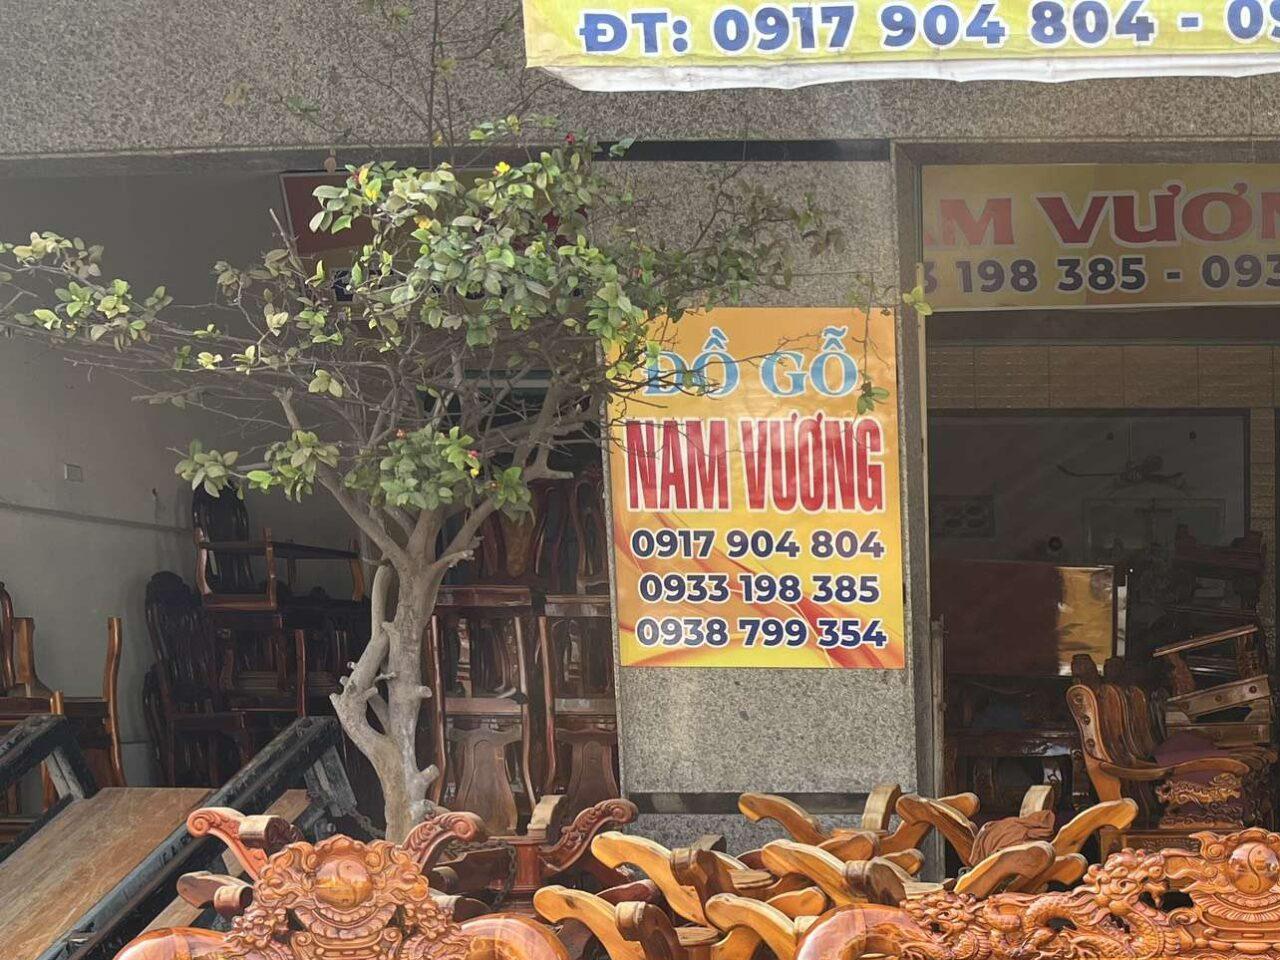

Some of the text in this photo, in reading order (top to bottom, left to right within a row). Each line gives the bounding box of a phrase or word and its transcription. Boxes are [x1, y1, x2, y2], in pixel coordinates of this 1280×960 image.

[580, 13, 688, 53] ĐT:
[714, 6, 854, 50] 0917
[881, 3, 1005, 47] 904
[1031, 0, 1154, 44] 804
[1181, 16, 1199, 28] -
[956, 259, 1038, 293] 198
[1057, 257, 1144, 290] 385
[643, 326, 858, 397] ĐỒ GỖ
[626, 412, 884, 511] NAM VƯƠNG
[632, 530, 884, 558] 0917 904 804
[640, 575, 880, 603] 0933 198 385
[637, 619, 887, 647] 0938 799 354
